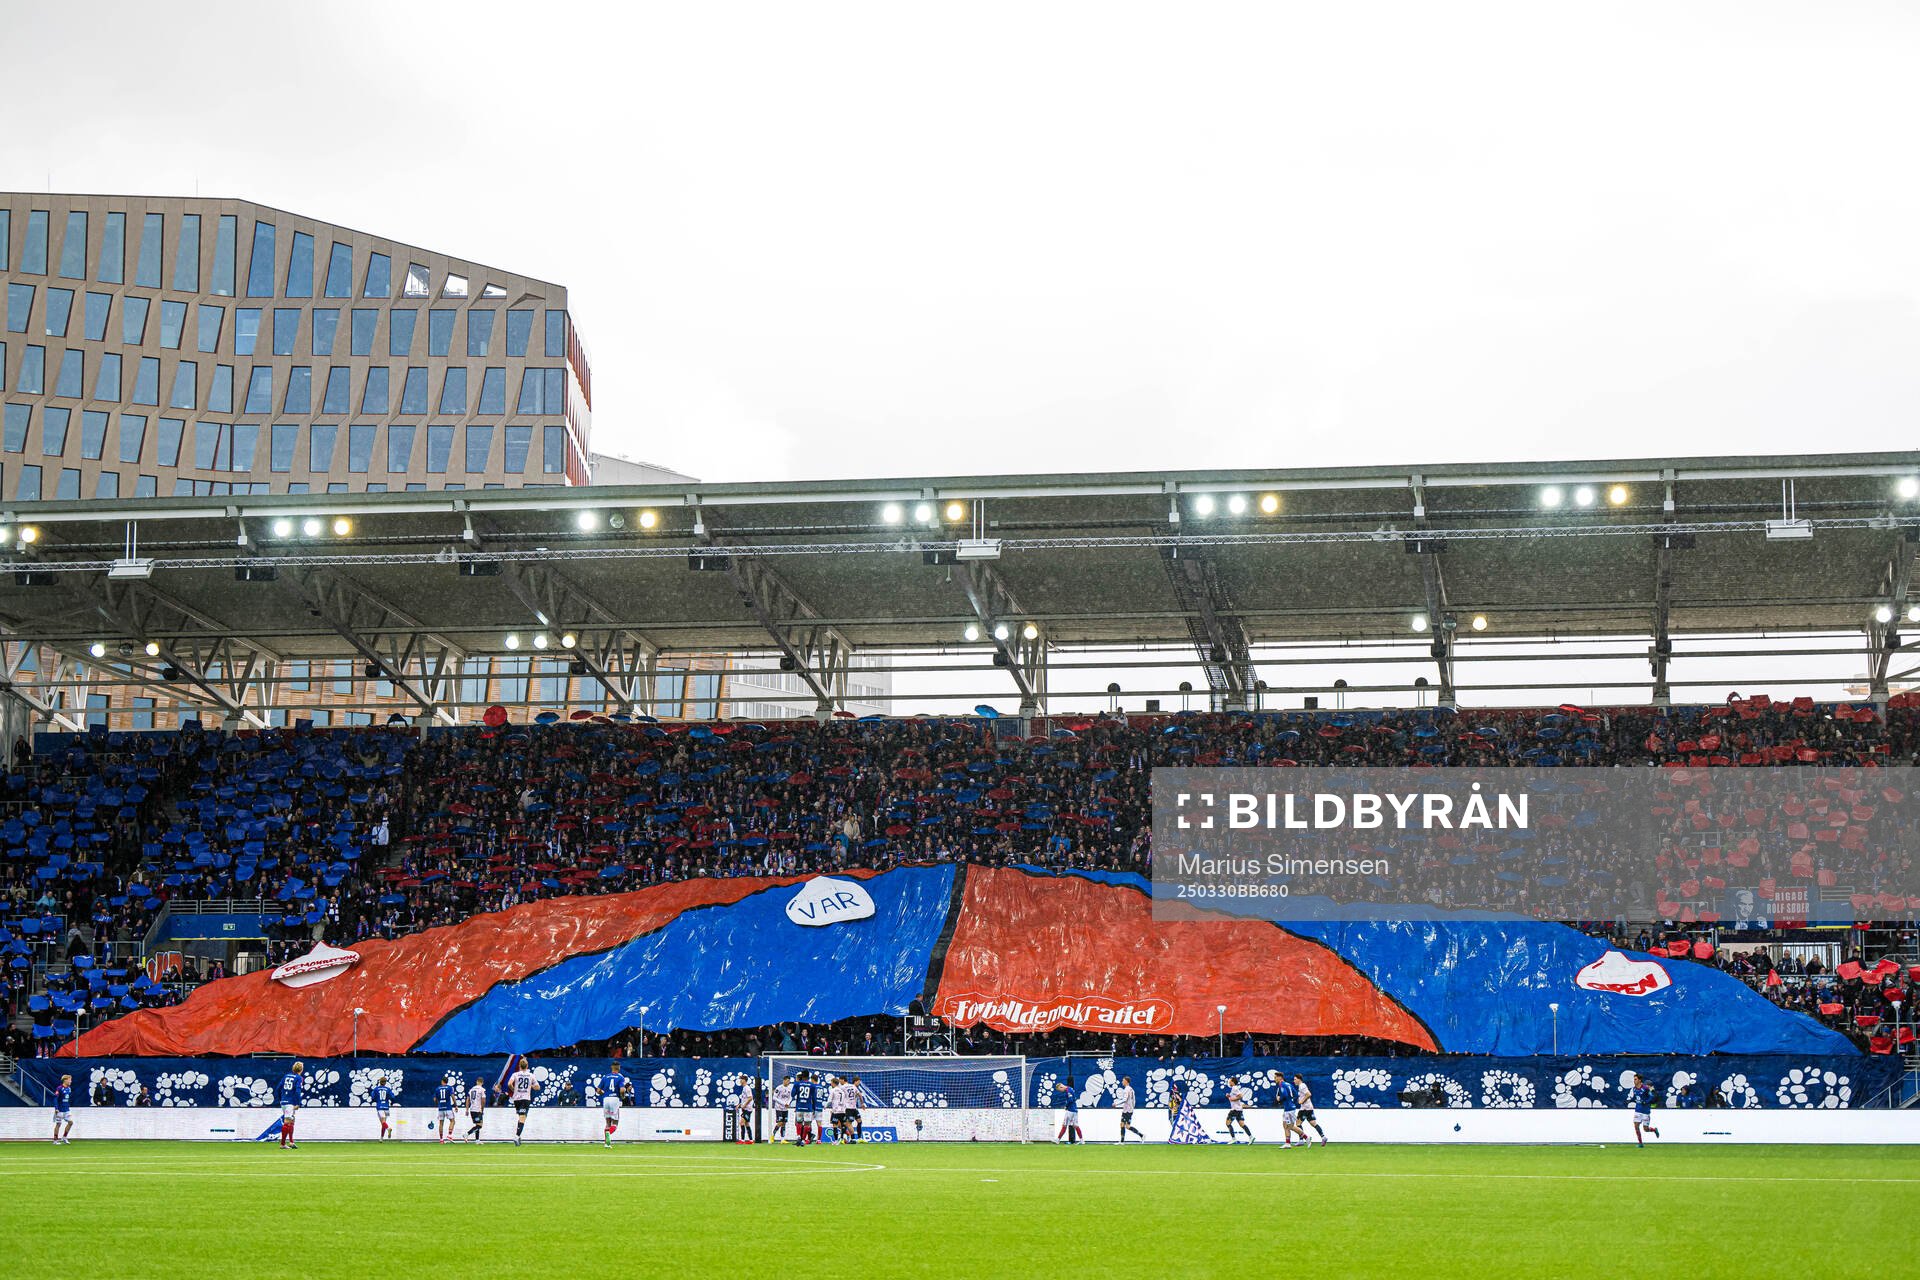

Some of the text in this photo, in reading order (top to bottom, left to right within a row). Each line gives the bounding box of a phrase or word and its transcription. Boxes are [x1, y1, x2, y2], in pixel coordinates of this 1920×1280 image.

[1768, 891, 1808, 901] RIGADE
[798, 892, 860, 919] VAR
[1766, 903, 1785, 914] ROLF
[954, 1000, 1156, 1025] Fotballdemokratiet
[283, 1077, 294, 1090] 55
[518, 1078, 529, 1090] 28
[609, 1079, 615, 1092] 4
[439, 1089, 446, 1099] 11
[799, 1086, 810, 1099] 29
